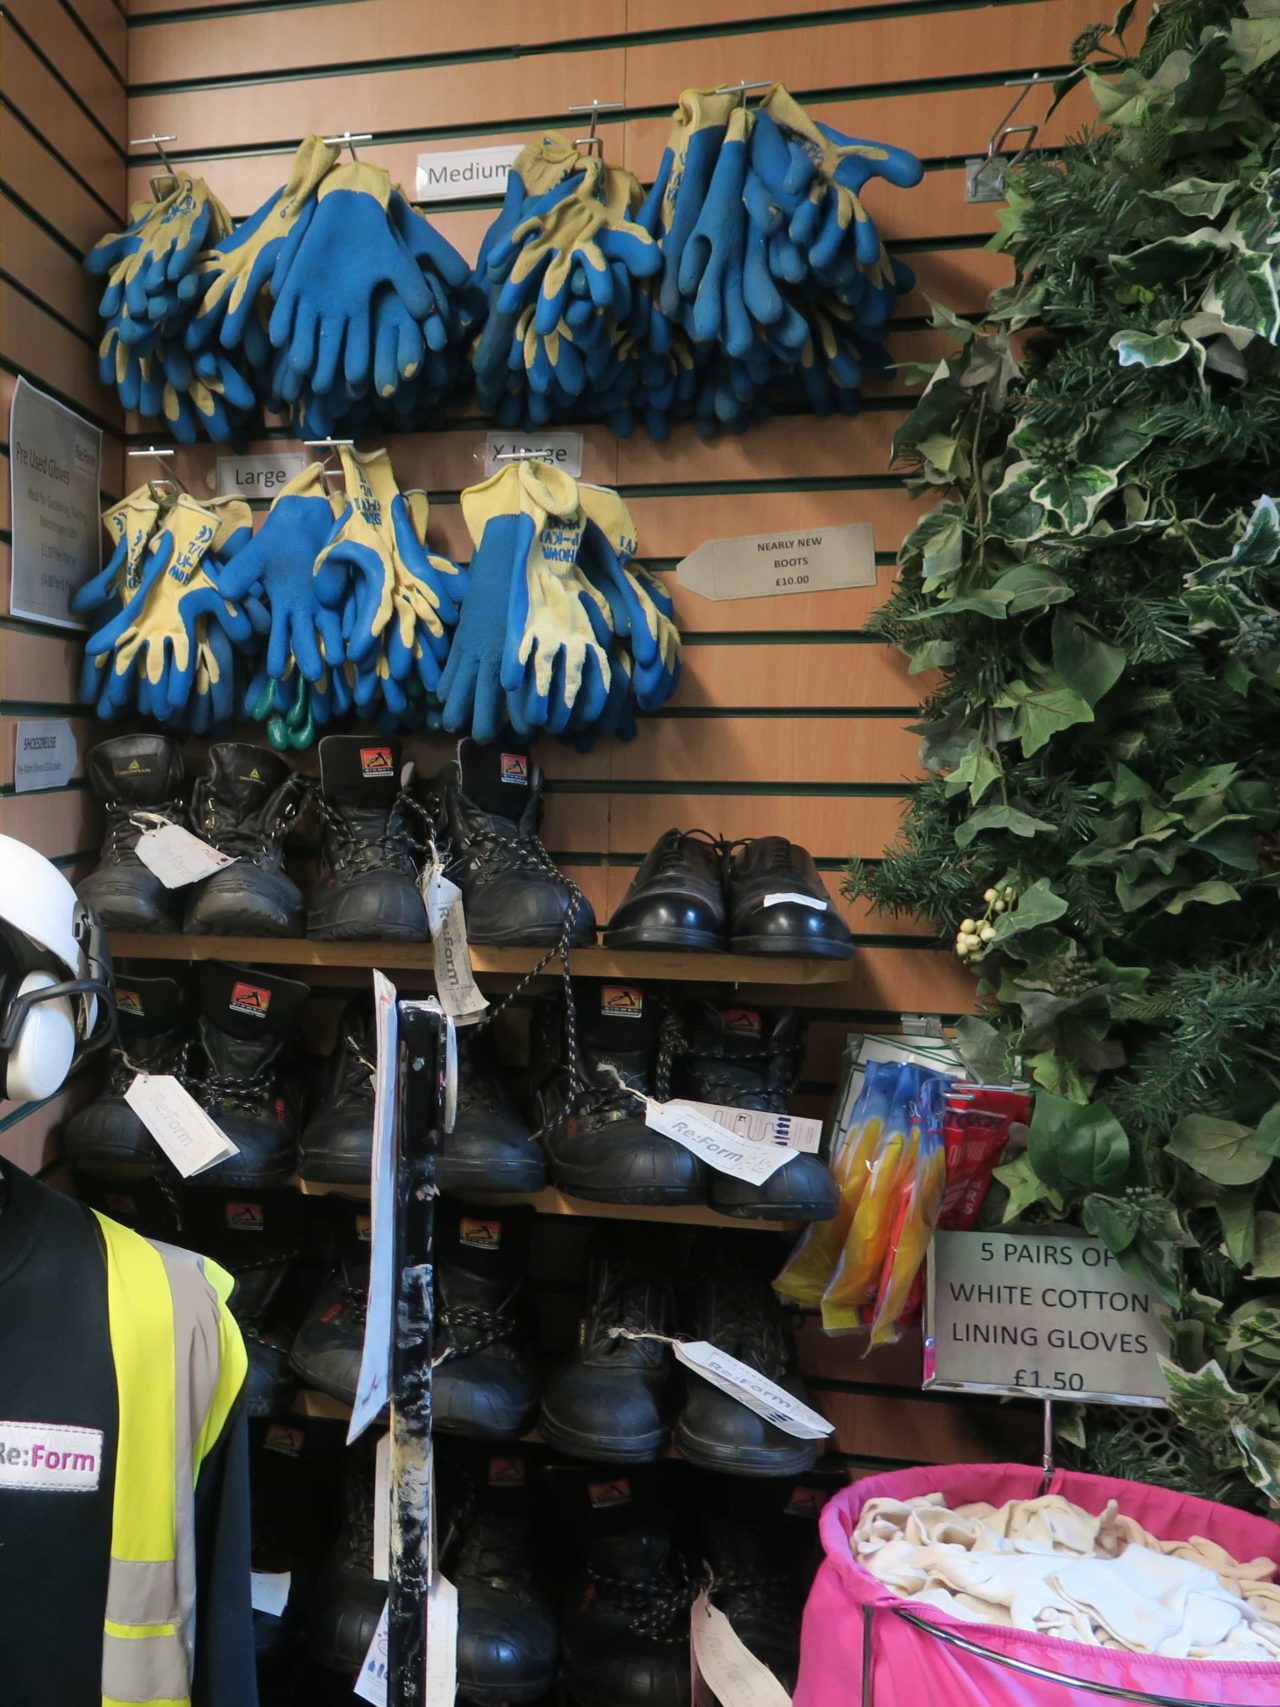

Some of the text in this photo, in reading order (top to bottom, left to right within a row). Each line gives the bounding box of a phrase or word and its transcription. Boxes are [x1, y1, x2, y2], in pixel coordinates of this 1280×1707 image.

[428, 162, 513, 185] Medium
[16, 441, 71, 486] Pre Used Gloves
[235, 468, 287, 488] Large
[757, 537, 823, 552] NEARLY NEW
[773, 557, 808, 568] BOOTS
[775, 575, 810, 587] £10.00
[437, 905, 460, 986] Re:Form
[670, 1121, 744, 1163] Re:Form
[980, 1242, 1116, 1268] 5 PAIRS OF
[949, 1282, 1150, 1314] WHITE COTTON
[952, 1322, 1149, 1354] LINING GLOVES
[707, 1361, 792, 1409] Re:Form
[1013, 1369, 1084, 1392] £1.50
